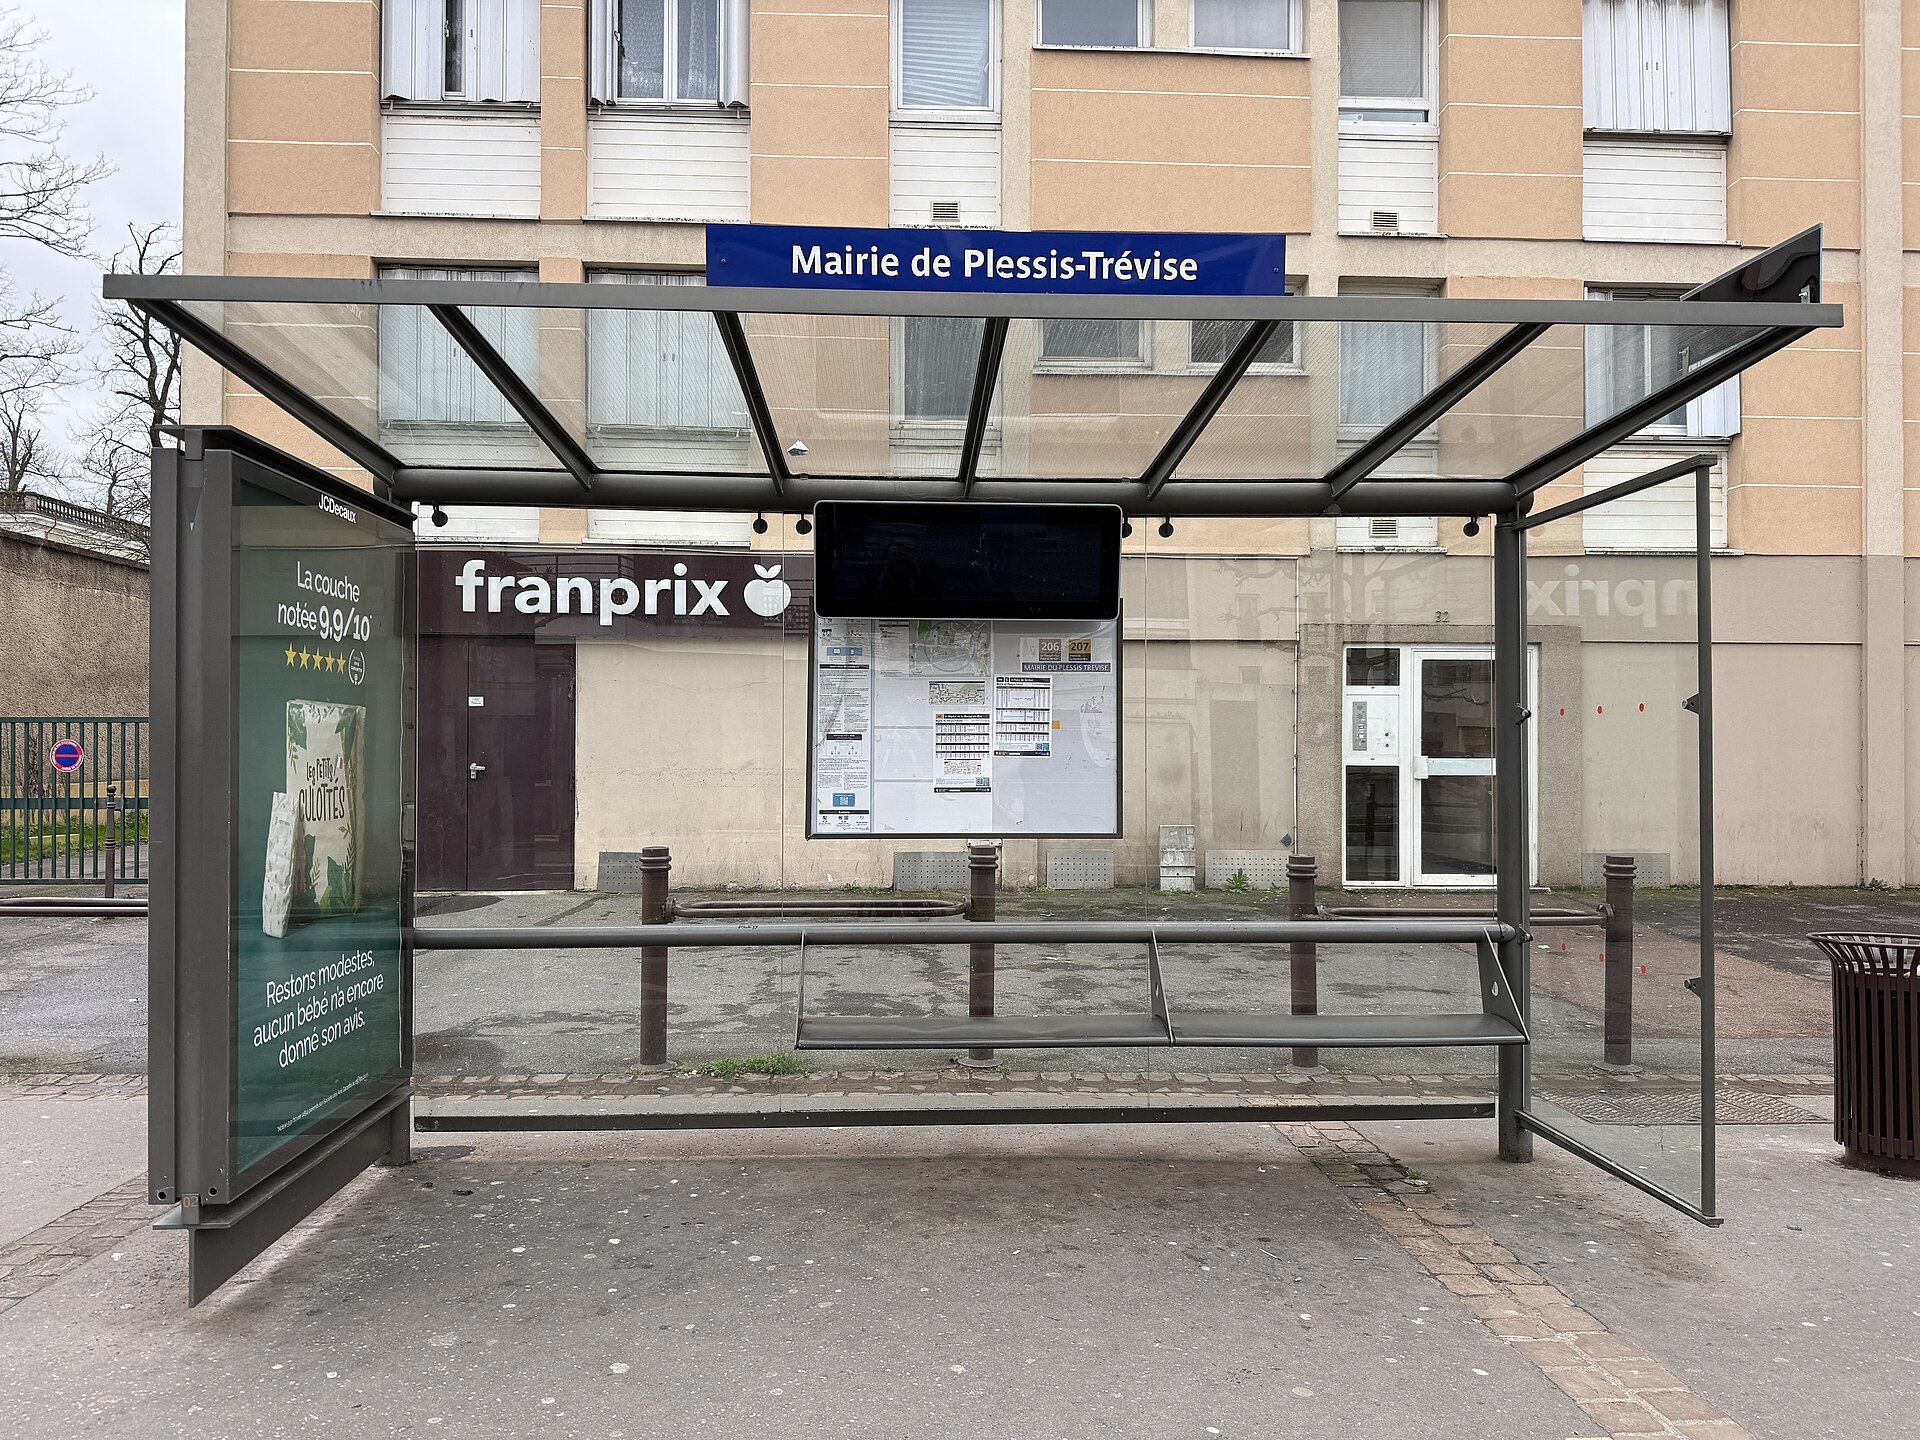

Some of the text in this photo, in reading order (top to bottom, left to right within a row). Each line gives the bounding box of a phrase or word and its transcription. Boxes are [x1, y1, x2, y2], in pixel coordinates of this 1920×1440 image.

[791, 244, 1198, 282] Mairie de Plessis-Trévise
[318, 494, 356, 523] JCDecaux
[296, 561, 360, 602] La couche
[455, 559, 731, 626] franprix
[277, 602, 317, 631] notée
[1435, 609, 1450, 623] 32
[1041, 642, 1060, 651] 206
[1071, 642, 1089, 651] 207
[266, 949, 375, 1008] Restons modestes,
[253, 973, 384, 1047] aucun bébé n'a encore
[278, 1007, 366, 1068] donné son avis.
